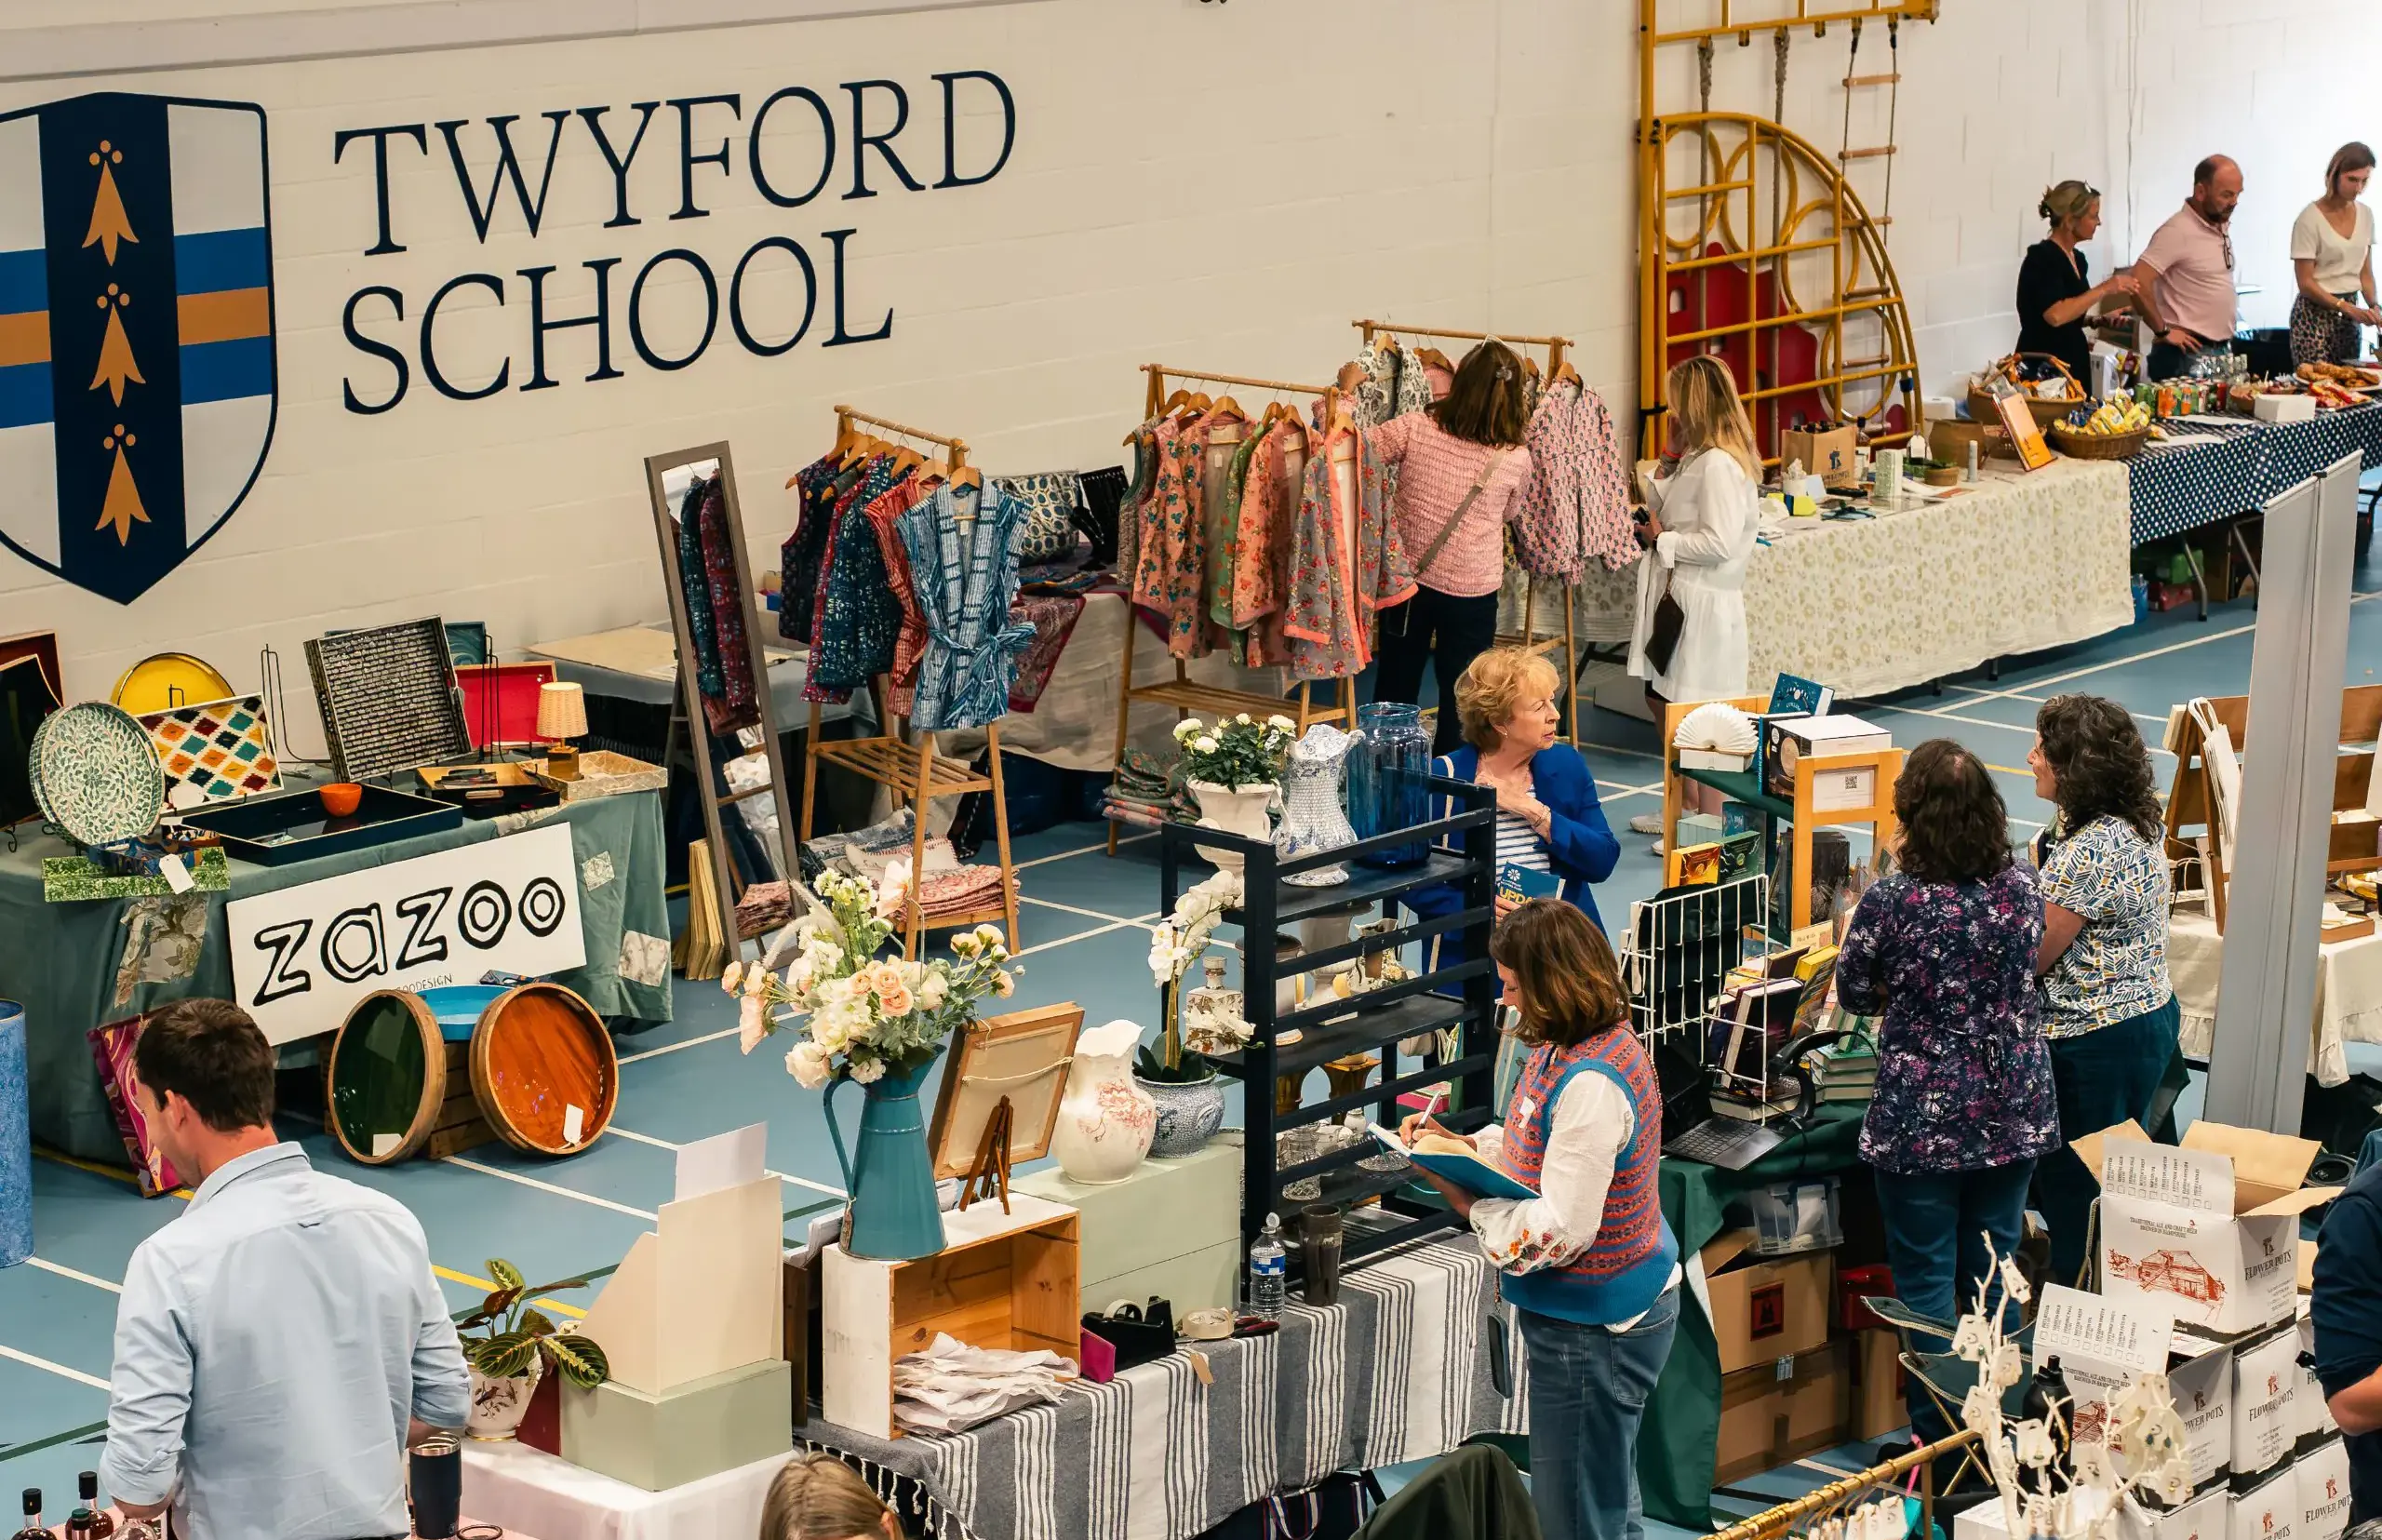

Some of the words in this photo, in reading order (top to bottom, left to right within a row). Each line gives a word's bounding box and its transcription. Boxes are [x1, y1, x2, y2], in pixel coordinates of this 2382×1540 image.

[334, 70, 1016, 257] TWYFORD
[343, 229, 893, 415] SCHOOL
[253, 877, 566, 1006] zazoo
[2244, 1260, 2274, 1281] FLOWER
[2275, 1250, 2292, 1266] POTS
[2184, 1415, 2205, 1430] OWER
[2205, 1403, 2224, 1422] POTS
[2249, 1399, 2279, 1422] FLOWER
[2306, 1503, 2336, 1523] FLOWER
[2337, 1494, 2351, 1509] POT
